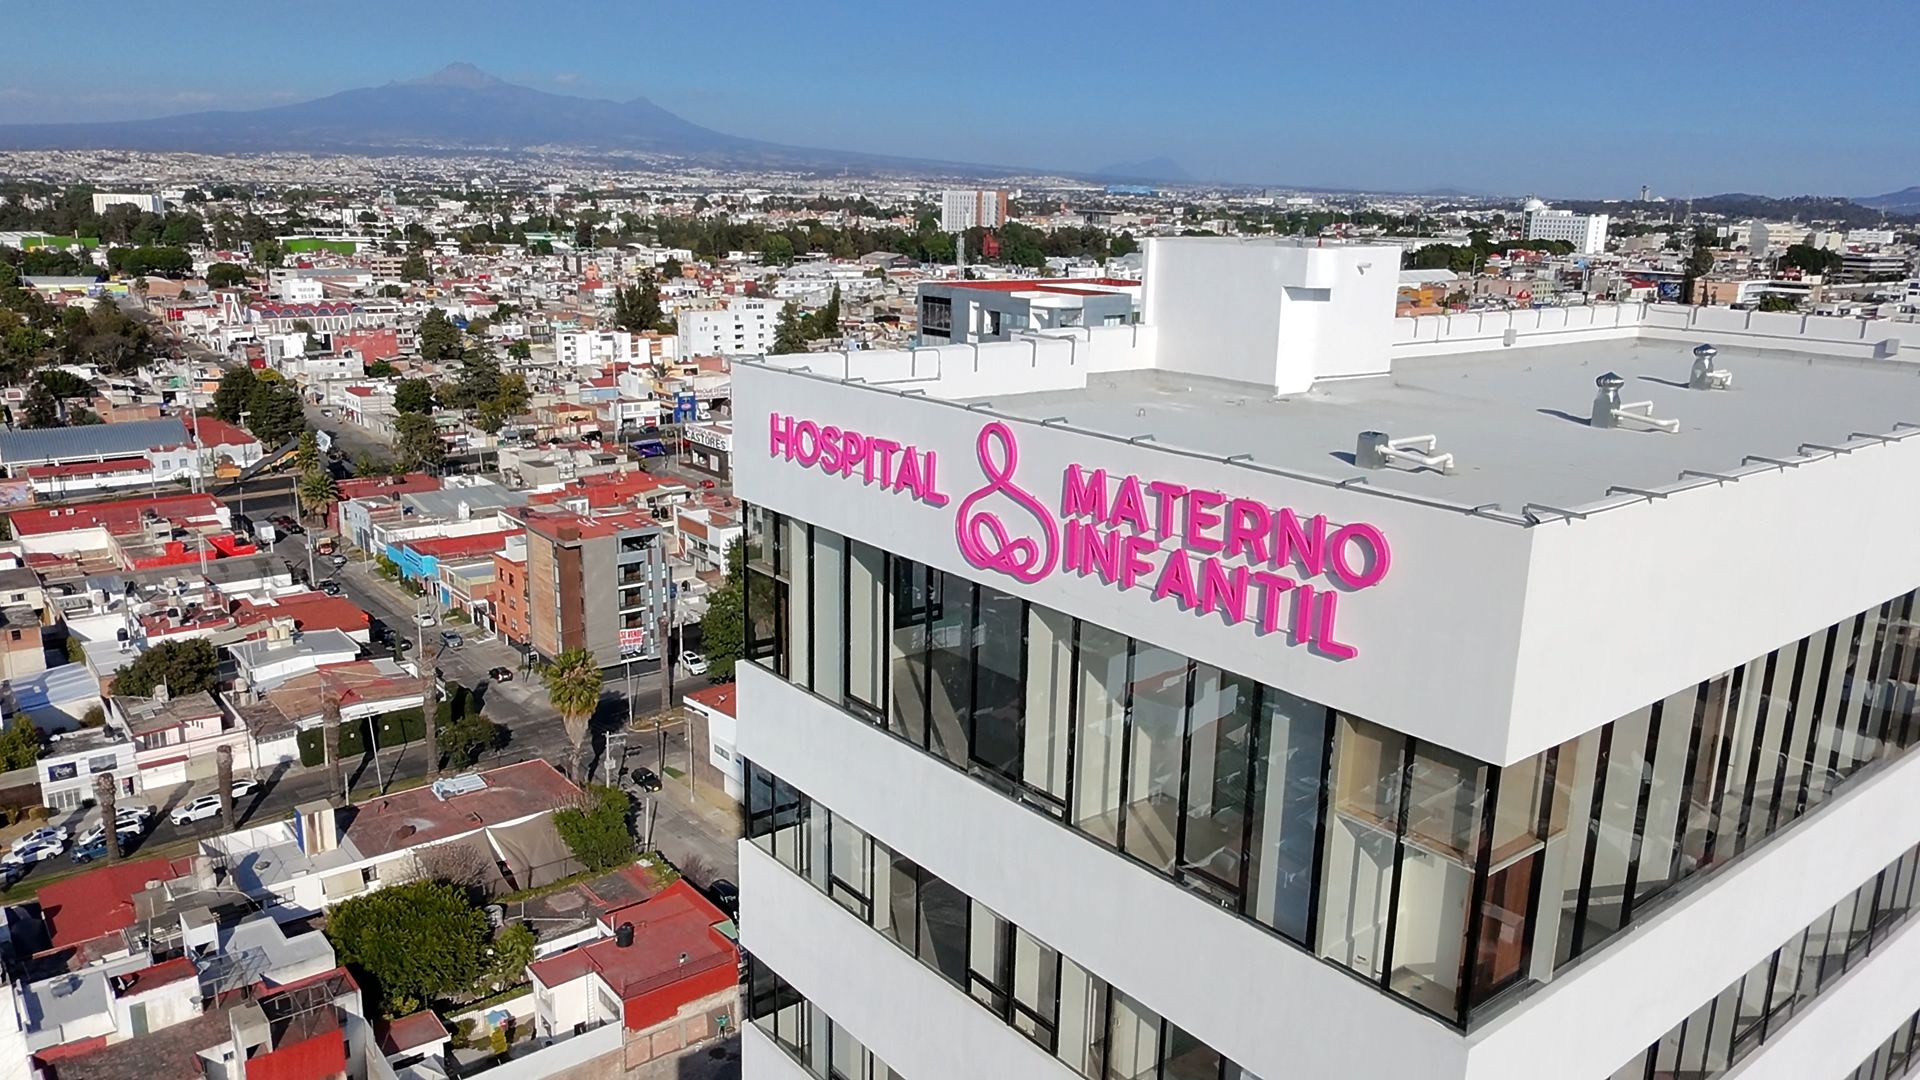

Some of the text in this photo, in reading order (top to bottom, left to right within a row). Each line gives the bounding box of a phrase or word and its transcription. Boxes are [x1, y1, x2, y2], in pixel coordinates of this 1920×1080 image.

[770, 412, 949, 505] HOSPITAL
[1062, 463, 1390, 590] MATERNO
[1064, 518, 1357, 659] INFANTIL
